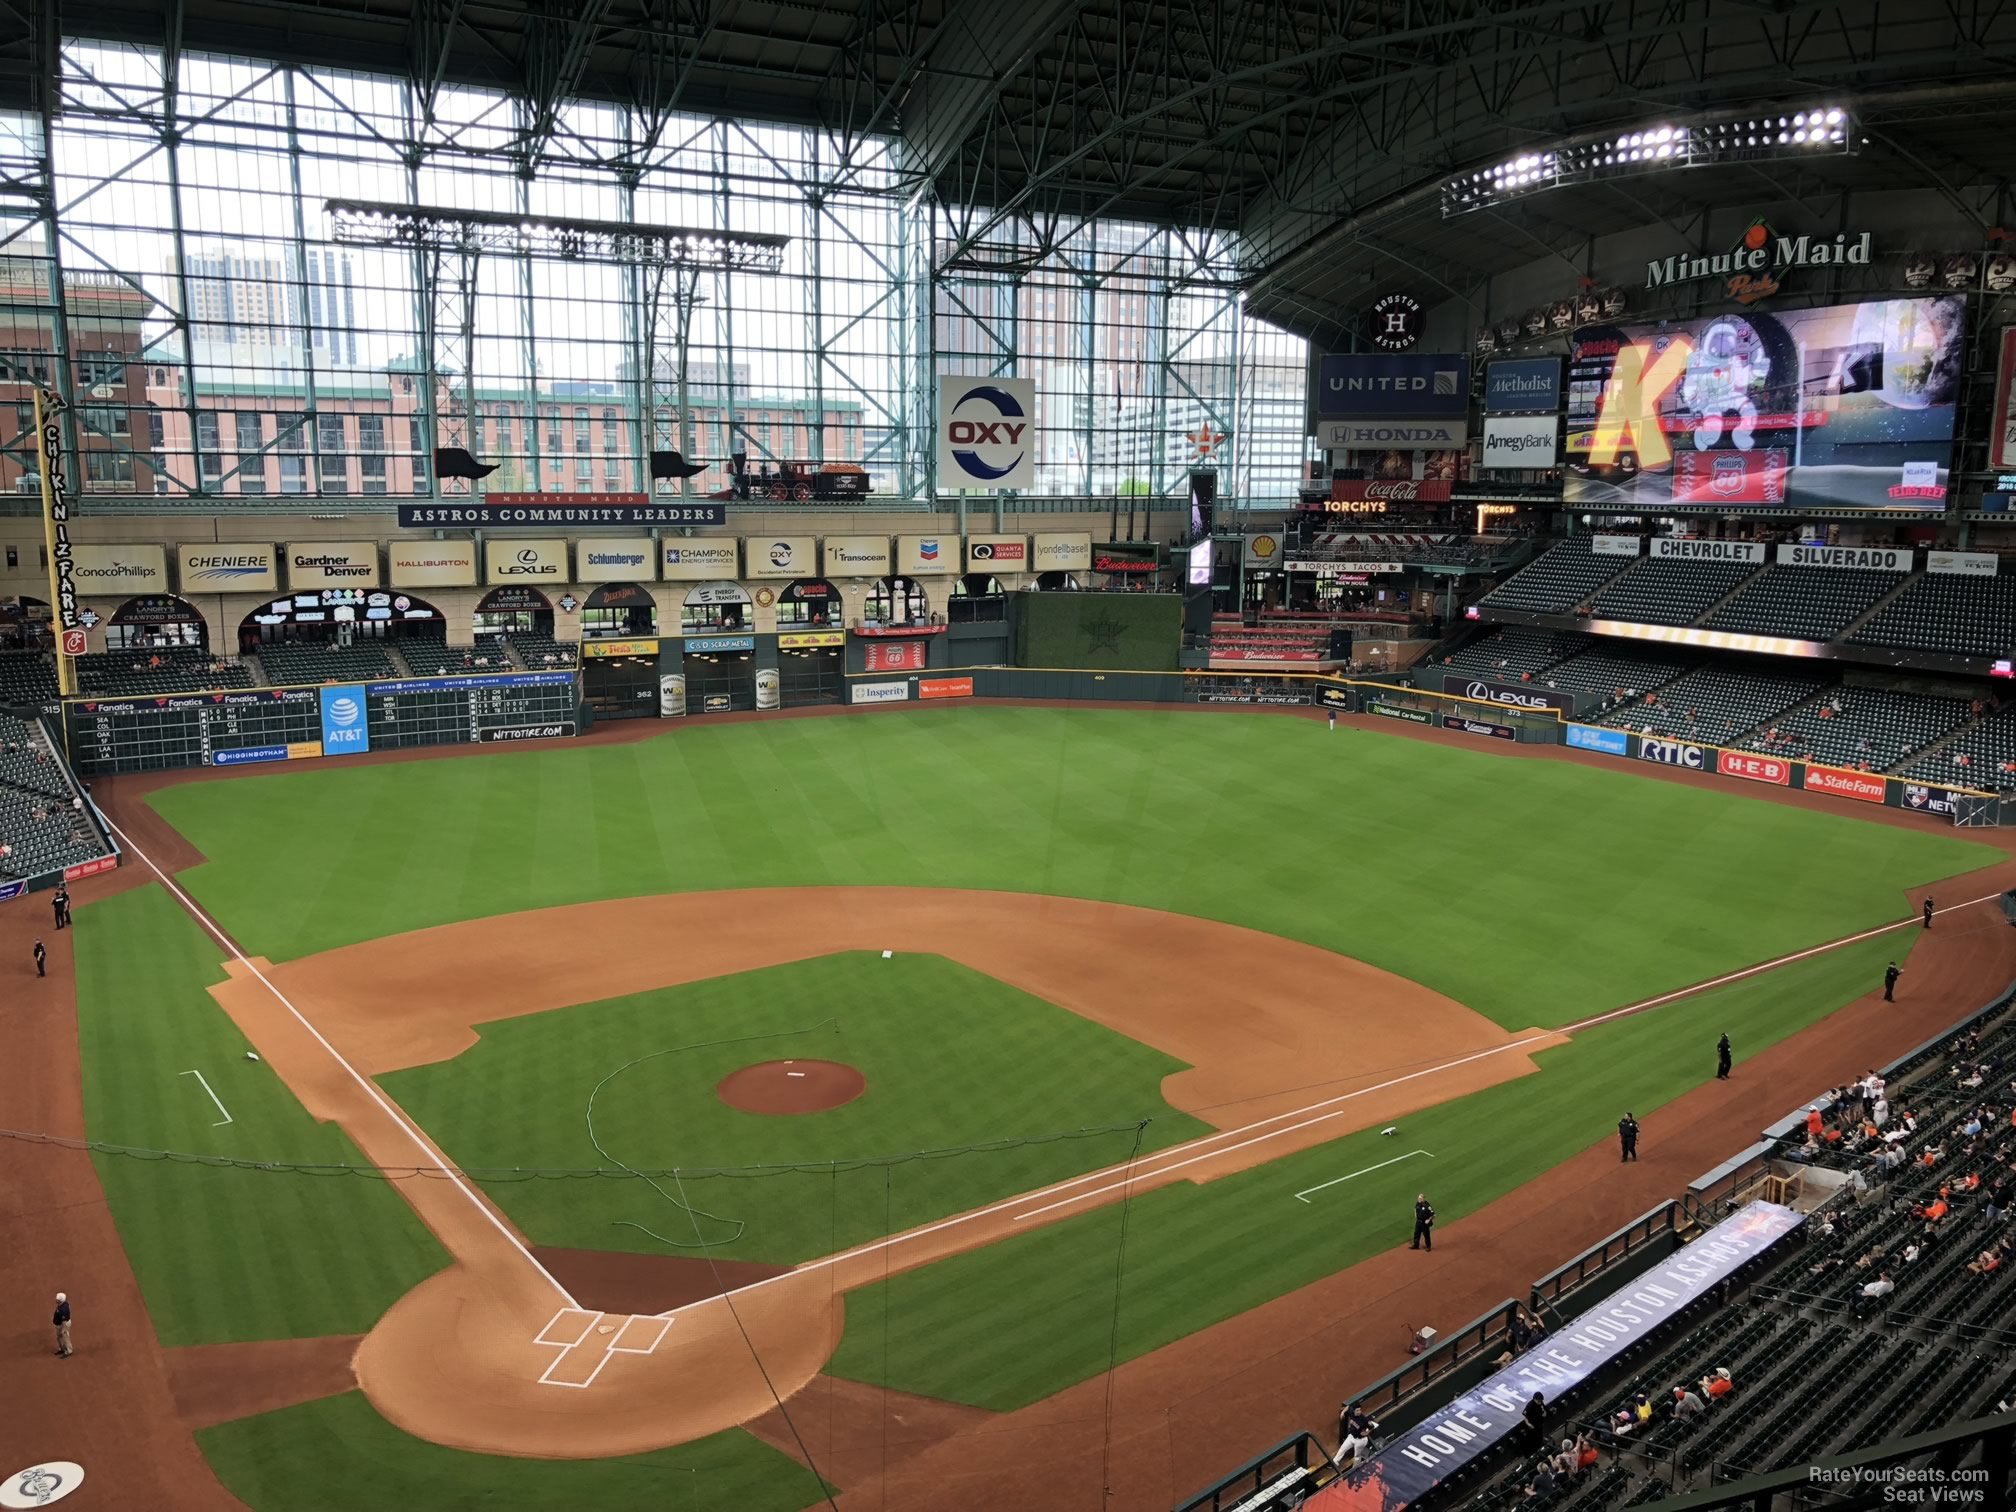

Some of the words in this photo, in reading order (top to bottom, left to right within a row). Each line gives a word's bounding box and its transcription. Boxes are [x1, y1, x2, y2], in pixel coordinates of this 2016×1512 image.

[1645, 247, 1766, 289] Minute
[1773, 232, 1871, 266] Maid
[1727, 273, 1780, 298] Park
[1375, 295, 1419, 312] HOUSTON
[1386, 313, 1406, 332] H
[1375, 335, 1415, 349] ASTROS
[1329, 376, 1427, 392] UNITED
[1491, 375, 1552, 392] Methodist
[1588, 338, 1694, 468] K
[949, 421, 1027, 445] OXY
[1353, 428, 1452, 442] HONDA
[1486, 433, 1553, 451] AmegyBank
[1715, 459, 1743, 468] PHILLIPS
[46, 427, 67, 520] CHIKIN
[1716, 471, 1740, 487] 66
[1920, 486, 1947, 498] BEEF
[1323, 501, 1387, 513] TORCHYS
[411, 509, 489, 521] ASTROS
[499, 509, 623, 521] COMMUNITY
[633, 508, 715, 520] LEADERS
[681, 549, 734, 557] CHAMPION
[1037, 543, 1089, 555] lyondellbasell
[1660, 540, 1754, 560] CHEVROLET
[188, 555, 268, 568] CHENIERE
[295, 555, 349, 566] Gardner
[396, 559, 469, 568] HALLIBURTON
[588, 553, 645, 566] Schlumberger
[839, 554, 886, 562] Transocean
[1095, 555, 1157, 571] Budweiser
[1792, 547, 1897, 568] SILVERADO
[75, 567, 156, 579] ConocoPhillips
[324, 566, 371, 577] Denver
[498, 565, 557, 575] LEXUS
[1353, 563, 1382, 571] TACOS
[59, 561, 76, 627] FARE
[711, 640, 730, 649] SCRAP
[731, 640, 750, 648] METAL
[888, 654, 900, 662] 66
[1243, 651, 1285, 660] Budweiser
[282, 690, 314, 700] Fanatics
[866, 687, 905, 698] Insperity
[1490, 690, 1547, 708] LEXUS
[168, 698, 203, 707] Fanatics
[224, 695, 258, 704] Fanatics
[41, 705, 61, 714] 315
[98, 703, 134, 712] Fanatics
[1379, 706, 1401, 718] National
[1401, 711, 1410, 719] Car
[1409, 713, 1426, 722] Rental
[200, 711, 209, 763] NATIONAL
[328, 728, 362, 742] AT&T
[493, 726, 562, 740] NITTOTIRE.COM
[226, 749, 284, 760] HIGGINBOTHAM
[1642, 737, 1701, 767] RTIC
[1400, 1409, 1492, 1468] HOME
[1482, 1383, 1527, 1412] OF
[1519, 1349, 1583, 1385] THE
[1569, 1283, 1679, 1352] HOUSTON
[1665, 1234, 1750, 1287] ASTROS
